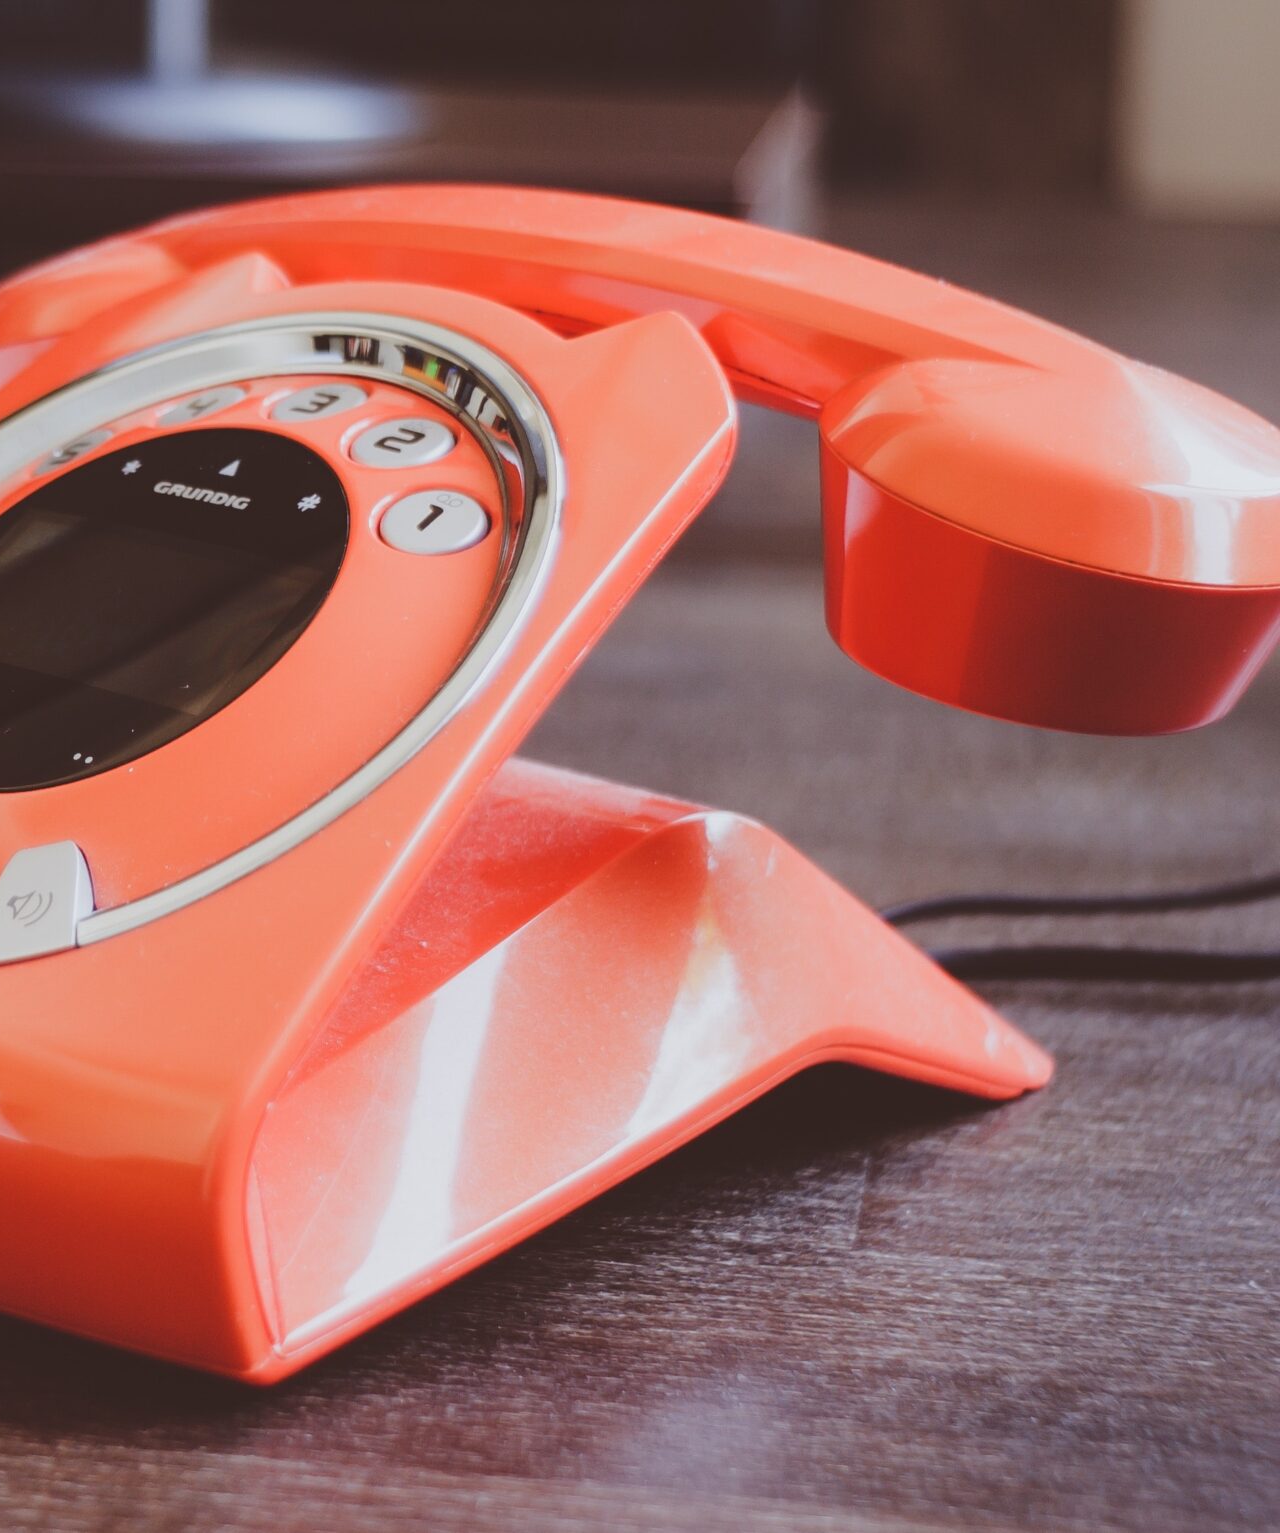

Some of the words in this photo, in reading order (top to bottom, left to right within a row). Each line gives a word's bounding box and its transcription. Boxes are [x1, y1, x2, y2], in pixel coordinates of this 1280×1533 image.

[291, 394, 340, 414] 3
[373, 426, 427, 454] 2
[153, 481, 251, 511] GRUNDIG
[417, 503, 444, 532] 1
